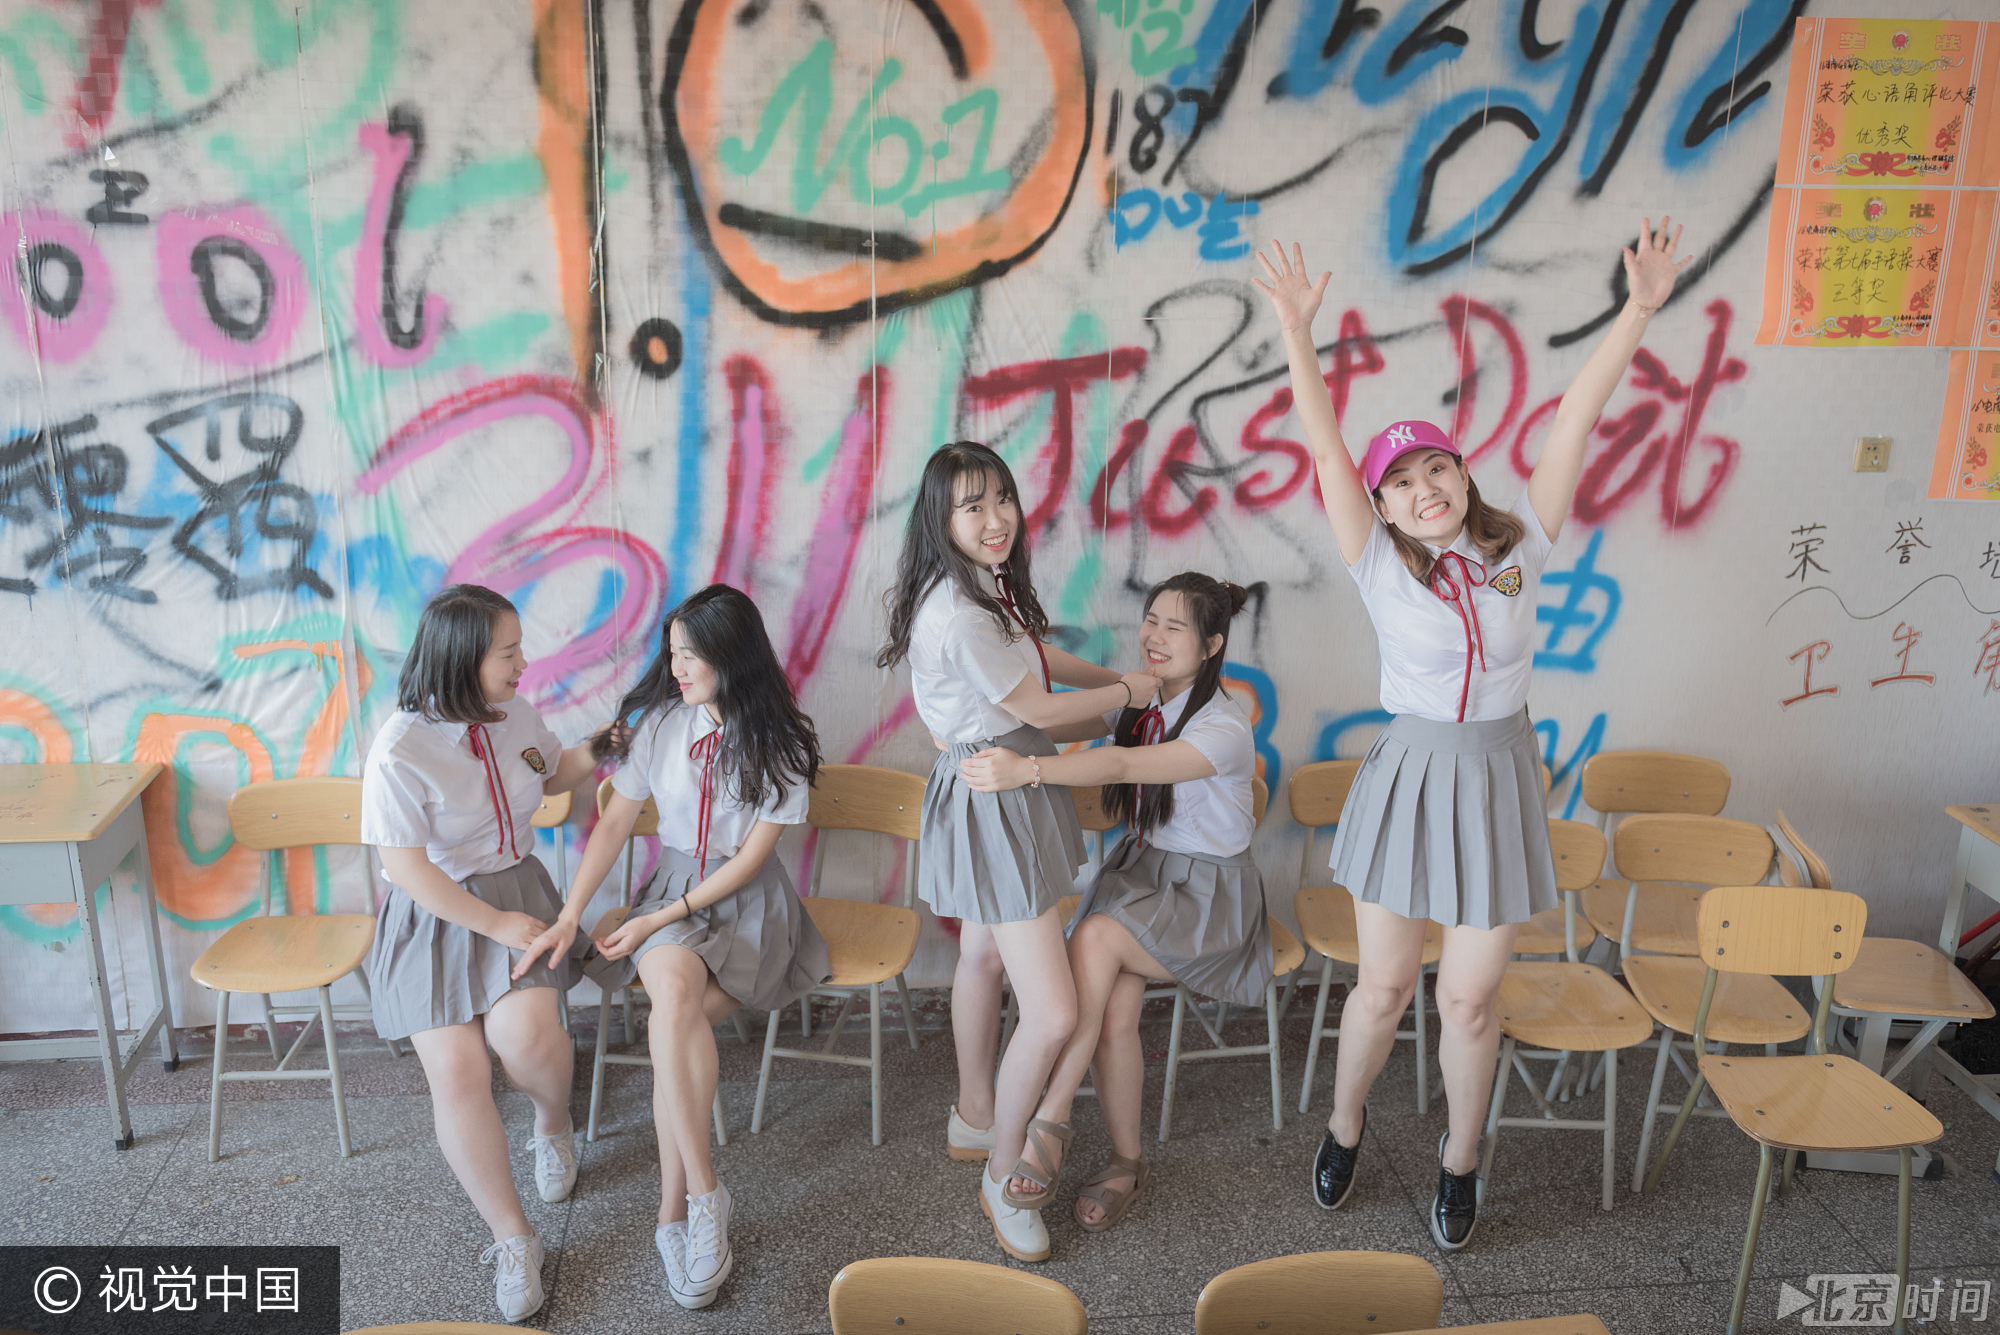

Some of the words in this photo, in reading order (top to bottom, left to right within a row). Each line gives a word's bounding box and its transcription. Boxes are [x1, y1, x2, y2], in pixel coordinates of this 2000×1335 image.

[1105, 84, 1212, 186] 187
[1856, 121, 1913, 149] 优秀奖
[1832, 276, 1888, 305] 三等奖
[1387, 425, 1416, 449] NY
